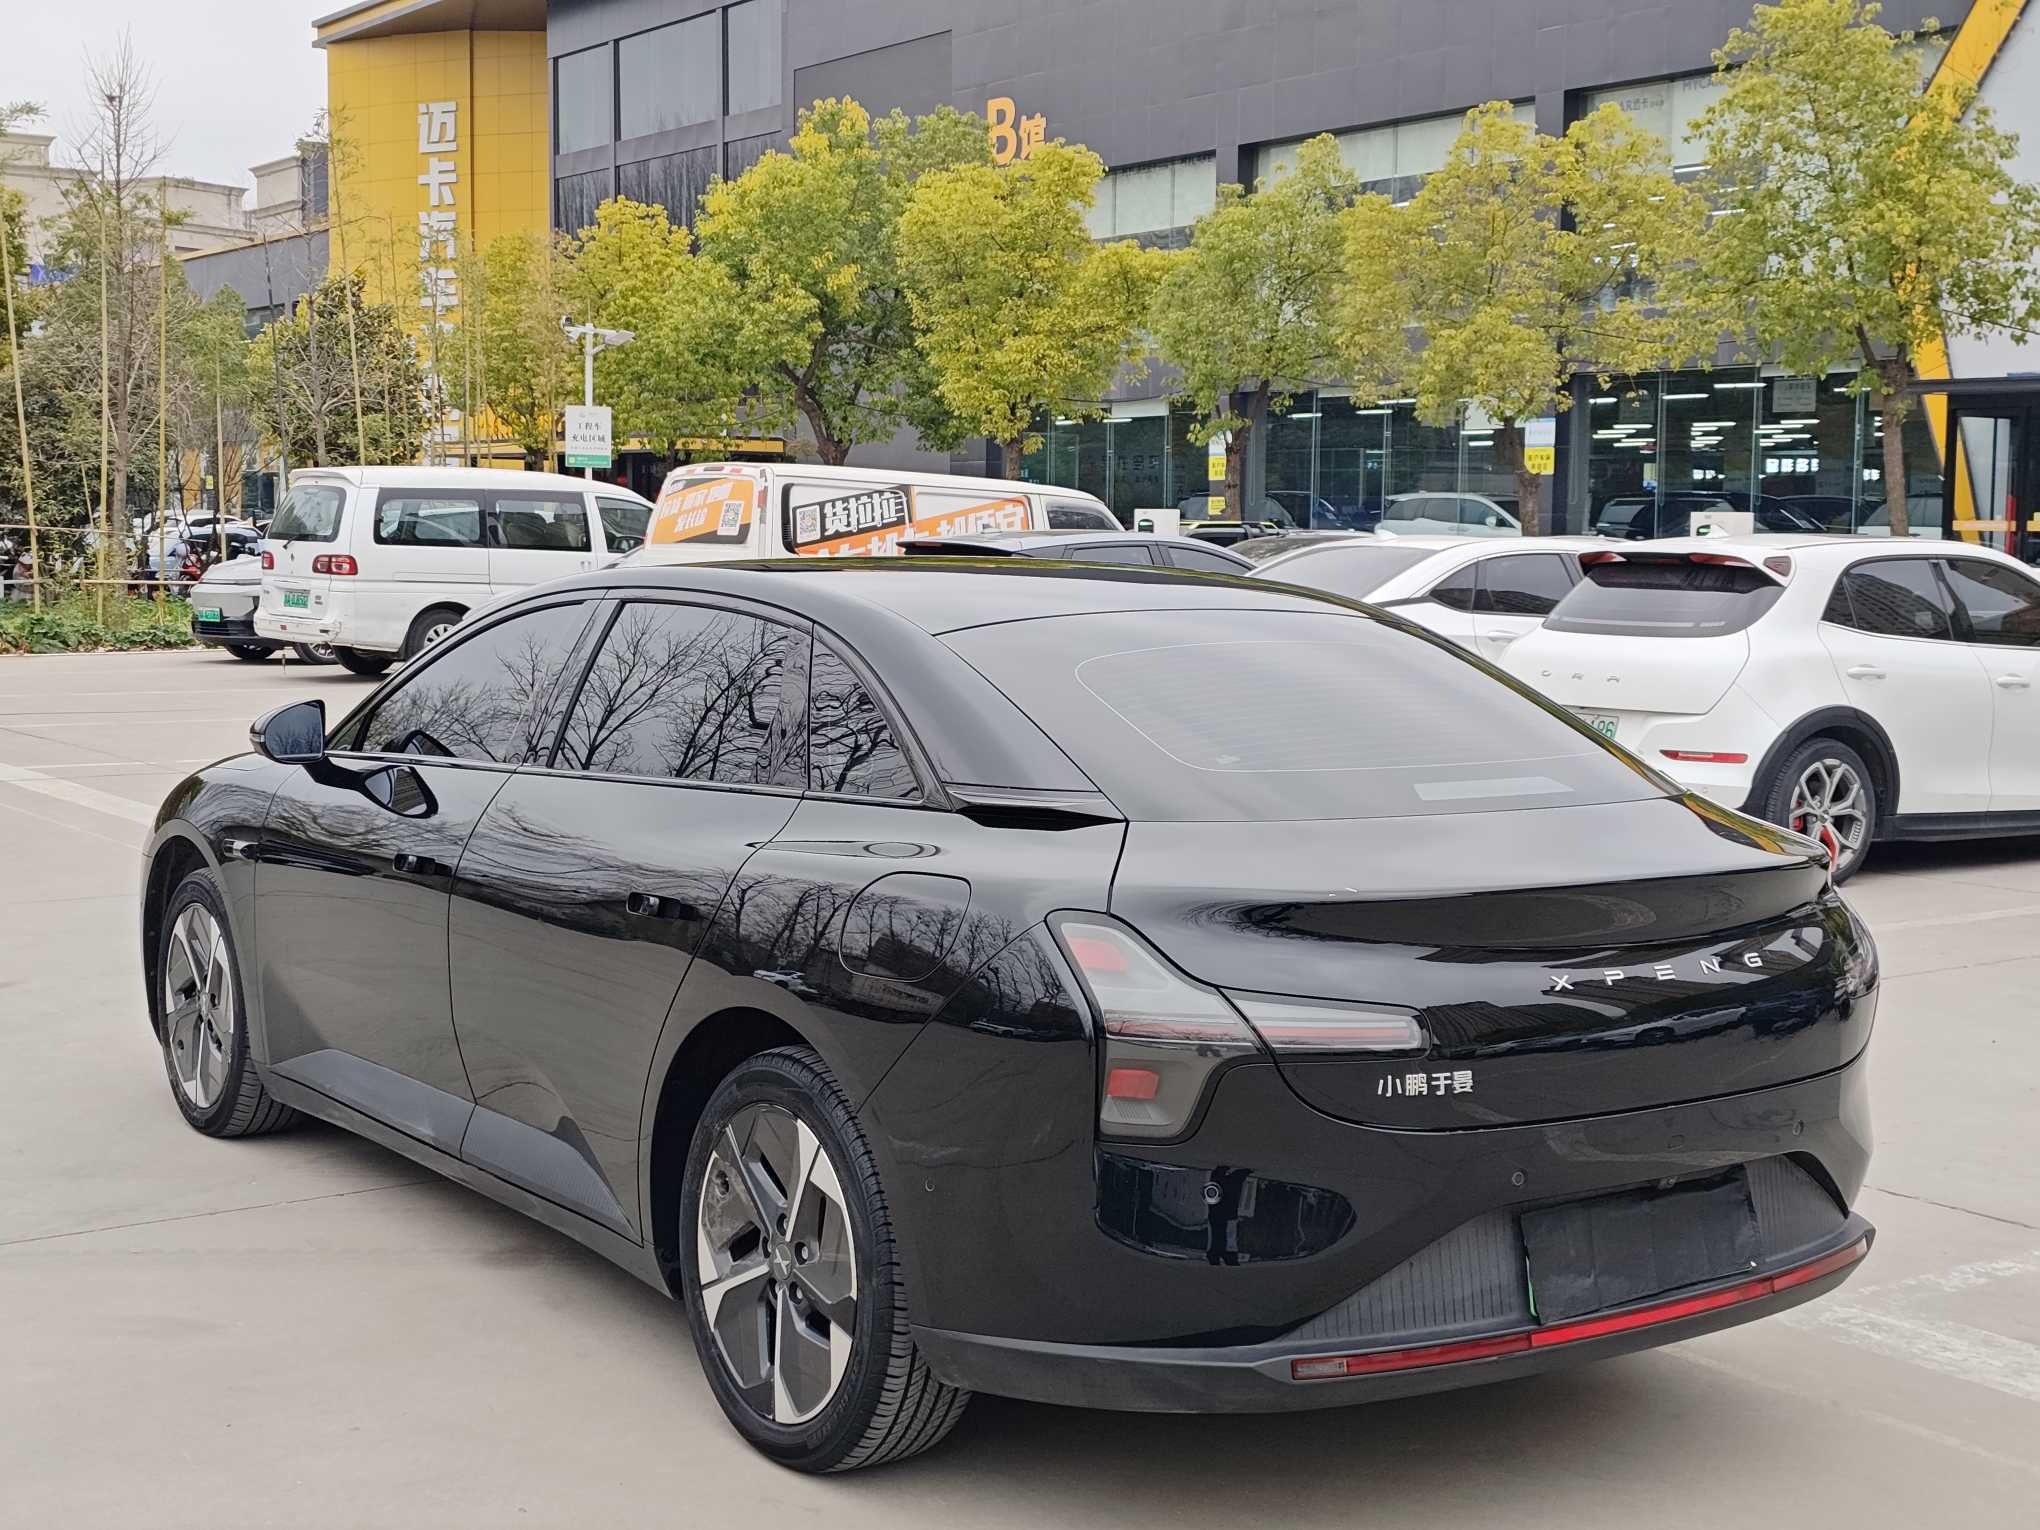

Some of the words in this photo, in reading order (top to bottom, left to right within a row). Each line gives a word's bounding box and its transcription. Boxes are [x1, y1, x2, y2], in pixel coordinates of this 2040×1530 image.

[824, 491, 899, 536] 货拉拉
[1551, 951, 1764, 992] XPENG
